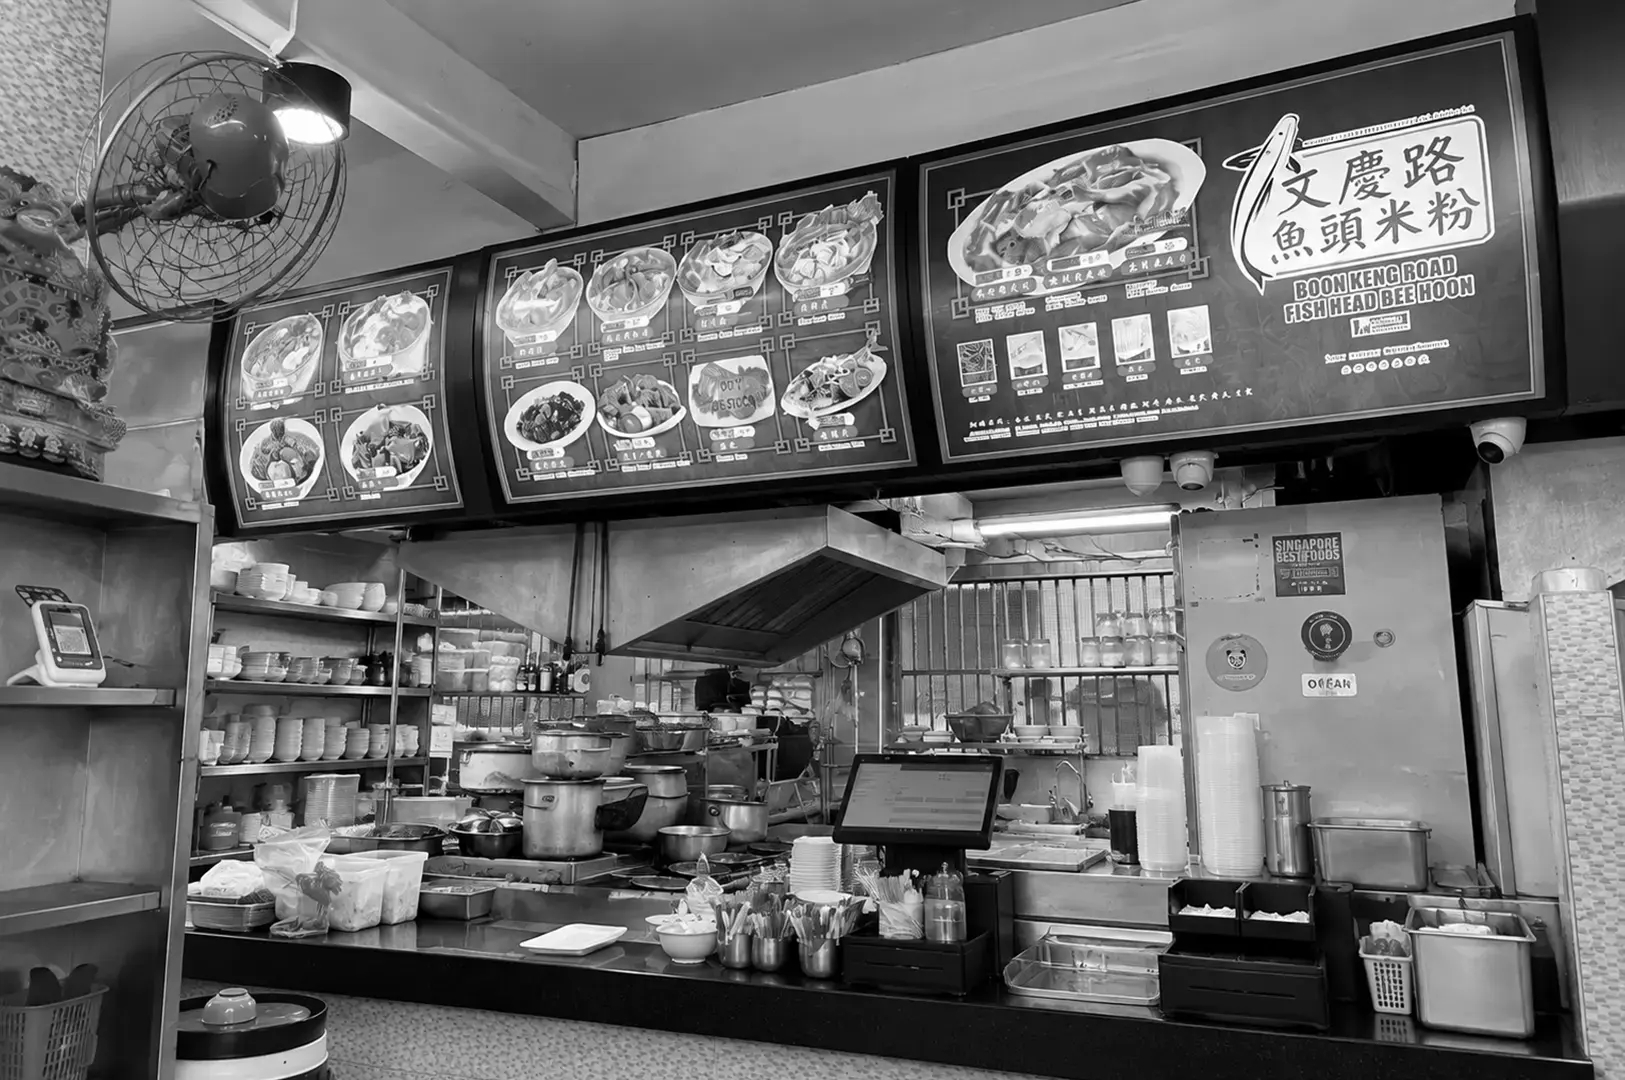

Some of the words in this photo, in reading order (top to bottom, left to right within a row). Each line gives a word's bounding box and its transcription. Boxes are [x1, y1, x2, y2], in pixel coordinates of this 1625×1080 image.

[1277, 136, 1465, 216] 文慶路
[1272, 188, 1480, 264] 魚頭米粉
[1284, 296, 1328, 323] FISH
[1329, 291, 1379, 317] HEAD
[1380, 284, 1416, 309] BEE
[1418, 275, 1475, 301] HOON
[1294, 274, 1347, 300] BOON
[1350, 265, 1400, 292] KENG
[1403, 255, 1457, 282] ROAD
[1275, 537, 1339, 552] SINGAPORE
[1276, 551, 1300, 563] BEST
[1303, 549, 1340, 562] FOODS
